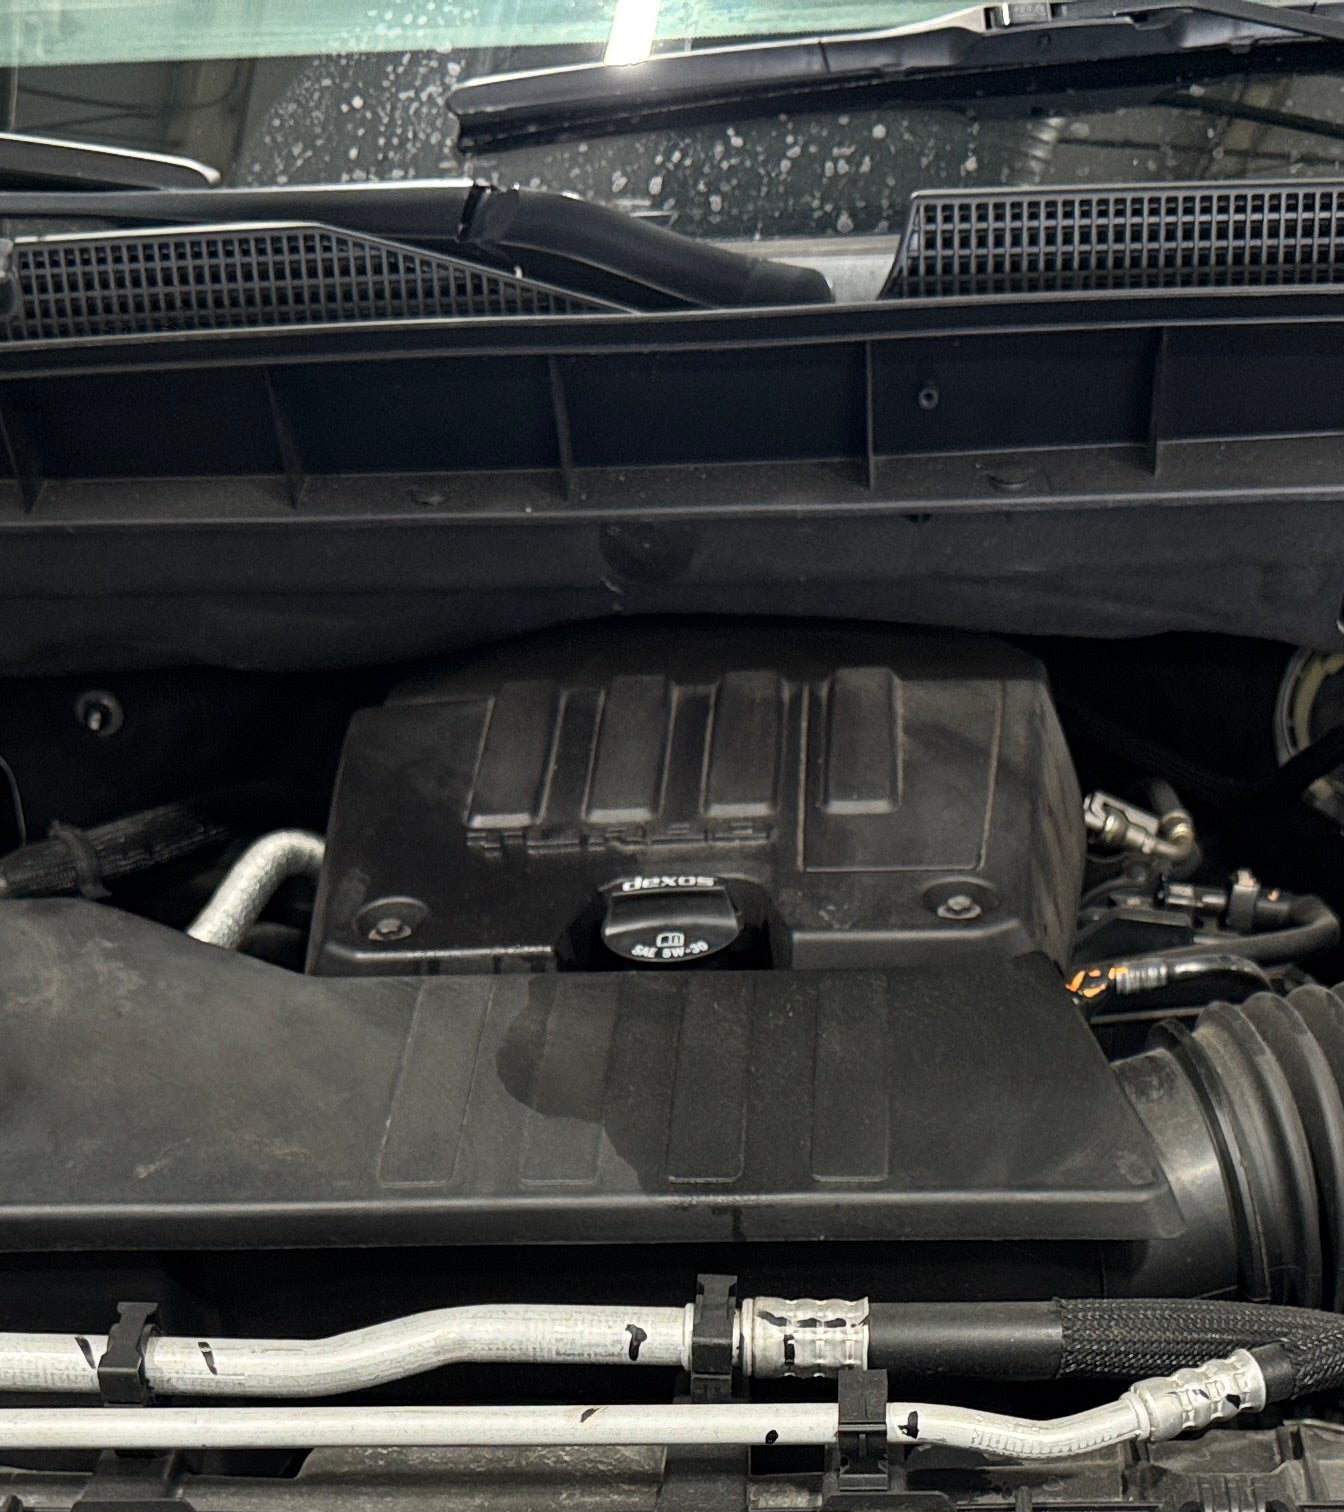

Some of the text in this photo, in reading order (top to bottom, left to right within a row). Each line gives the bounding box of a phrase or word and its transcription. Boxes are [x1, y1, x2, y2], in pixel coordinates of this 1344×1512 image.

[622, 876, 714, 891] dexos
[631, 940, 709, 958] SAE 5W-30
